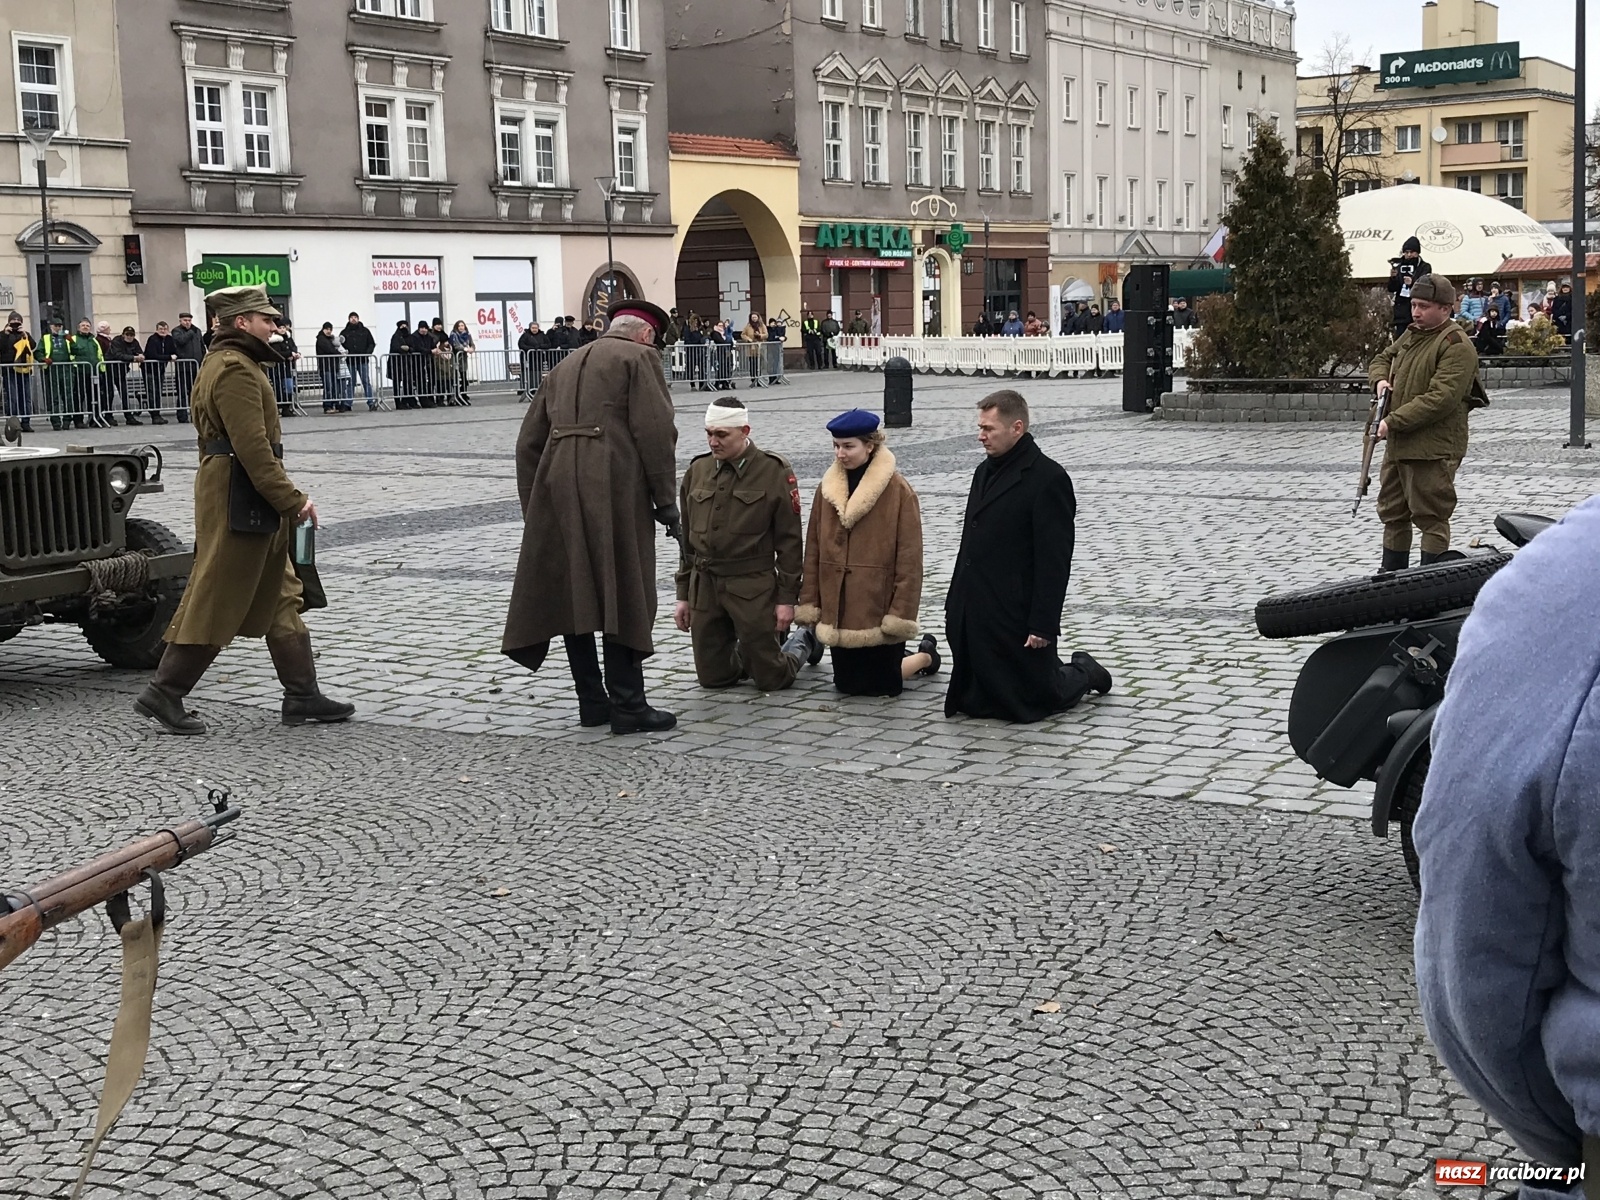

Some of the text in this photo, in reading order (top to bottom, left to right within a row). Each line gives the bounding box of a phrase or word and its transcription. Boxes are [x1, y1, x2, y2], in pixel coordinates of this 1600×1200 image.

[1414, 58, 1484, 73] McDonald's
[1385, 76, 1401, 84] 300
[816, 222, 912, 248] APTEKA
[1342, 227, 1394, 241] CIBÓRZ
[195, 269, 224, 280] żabka
[231, 265, 280, 286] abka
[382, 281, 398, 290] 880
[402, 281, 417, 290] 201
[421, 281, 436, 290] 117
[508, 306, 518, 323] 880
[592, 290, 608, 331] DYM
